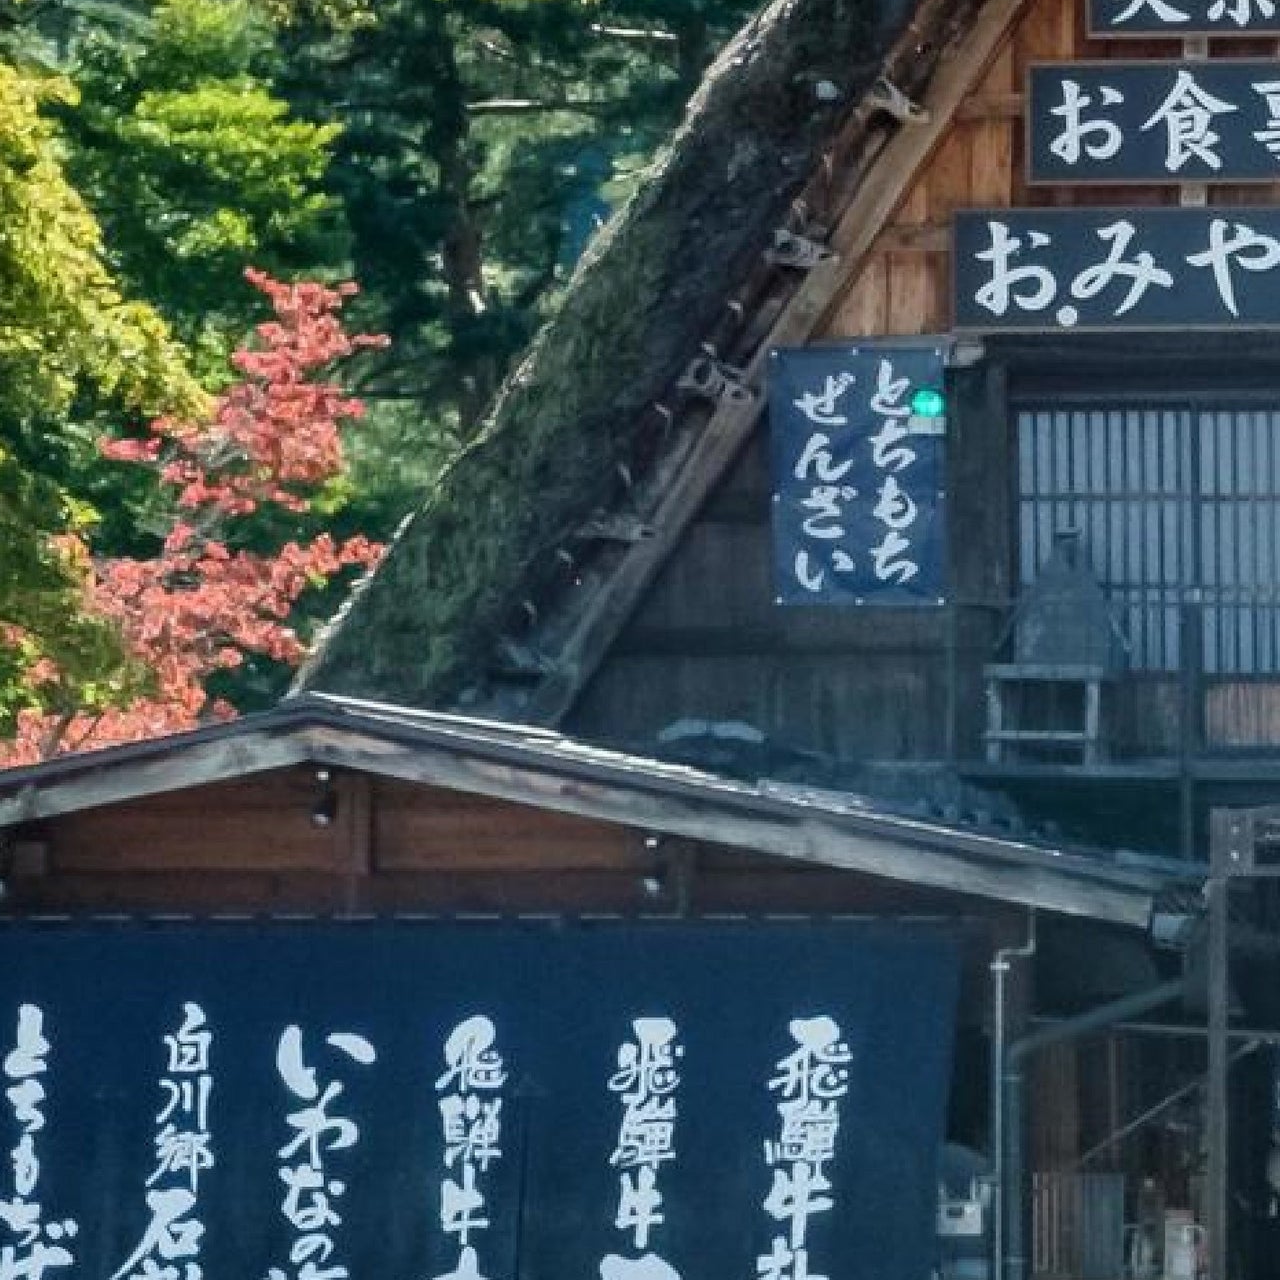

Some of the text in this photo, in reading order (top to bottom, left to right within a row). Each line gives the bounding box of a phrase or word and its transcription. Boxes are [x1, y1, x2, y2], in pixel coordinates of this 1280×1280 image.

[794, 372, 858, 592] ぜんざい
[868, 359, 918, 584] とちもち
